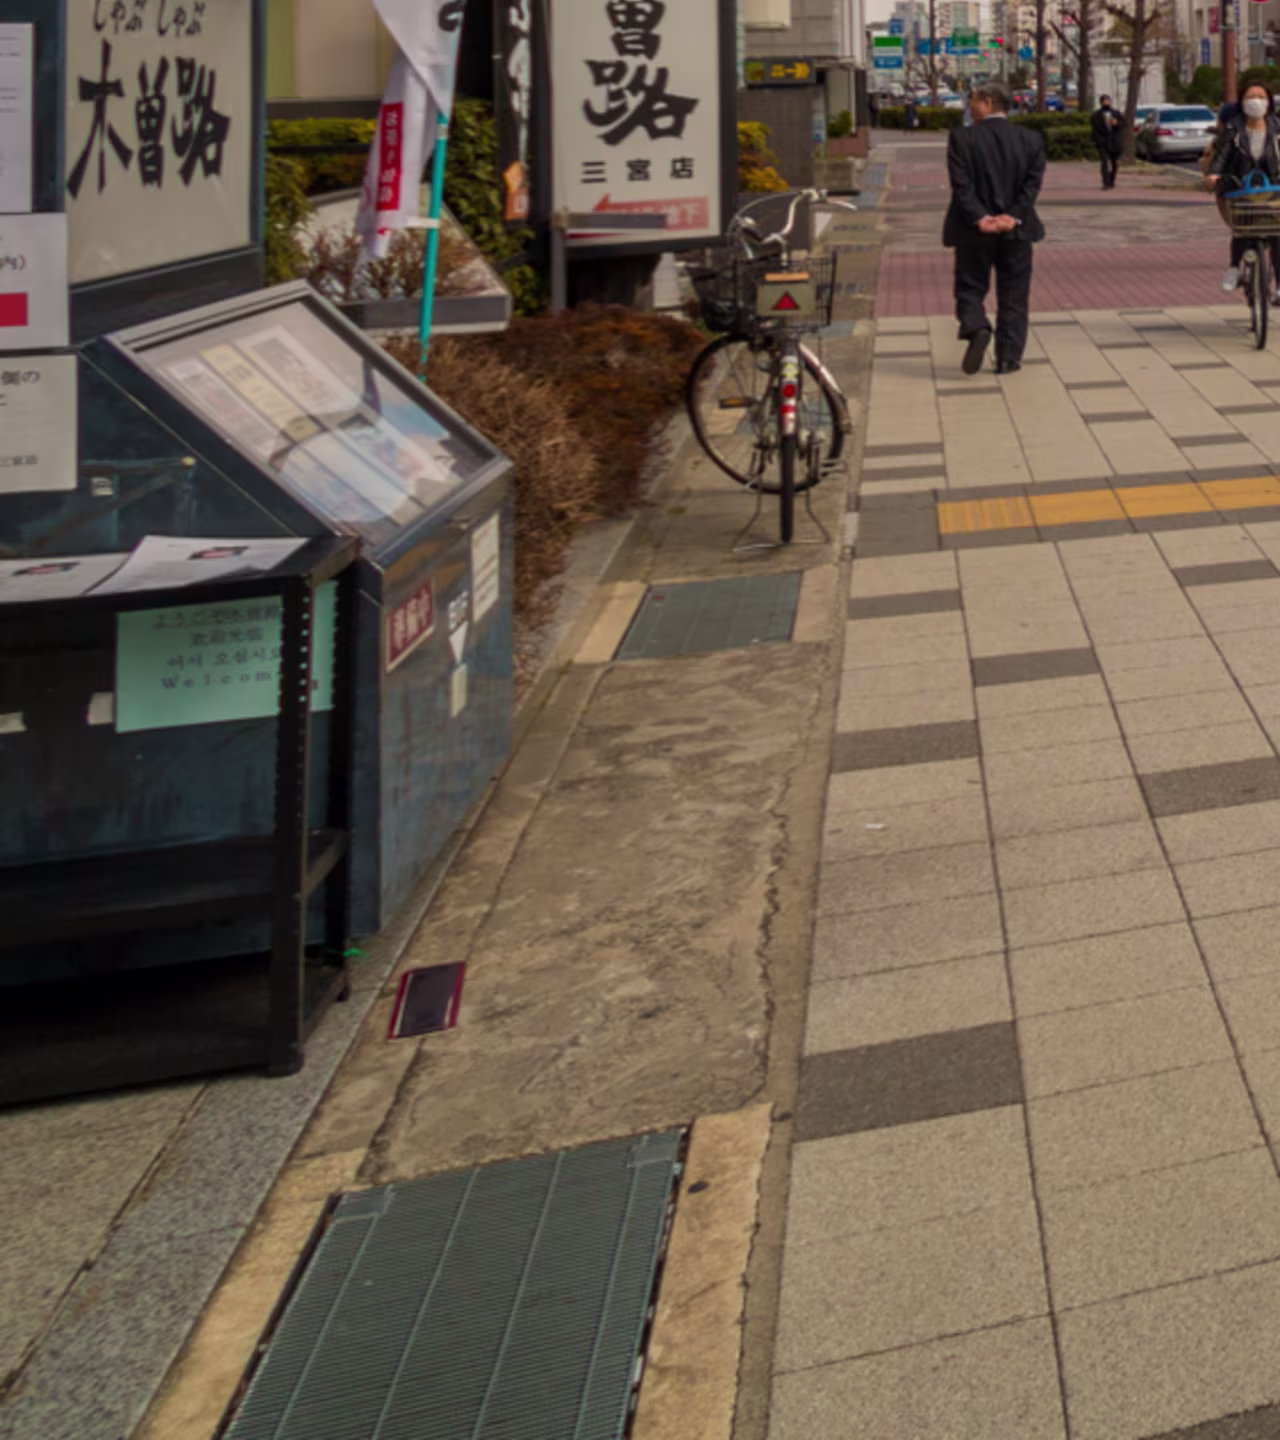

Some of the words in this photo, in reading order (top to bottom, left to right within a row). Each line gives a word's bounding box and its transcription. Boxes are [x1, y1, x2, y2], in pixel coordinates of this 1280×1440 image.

[66, 38, 231, 201] 木曽路
[580, 157, 694, 184] 三宮店
[161, 670, 274, 689] Welcom
